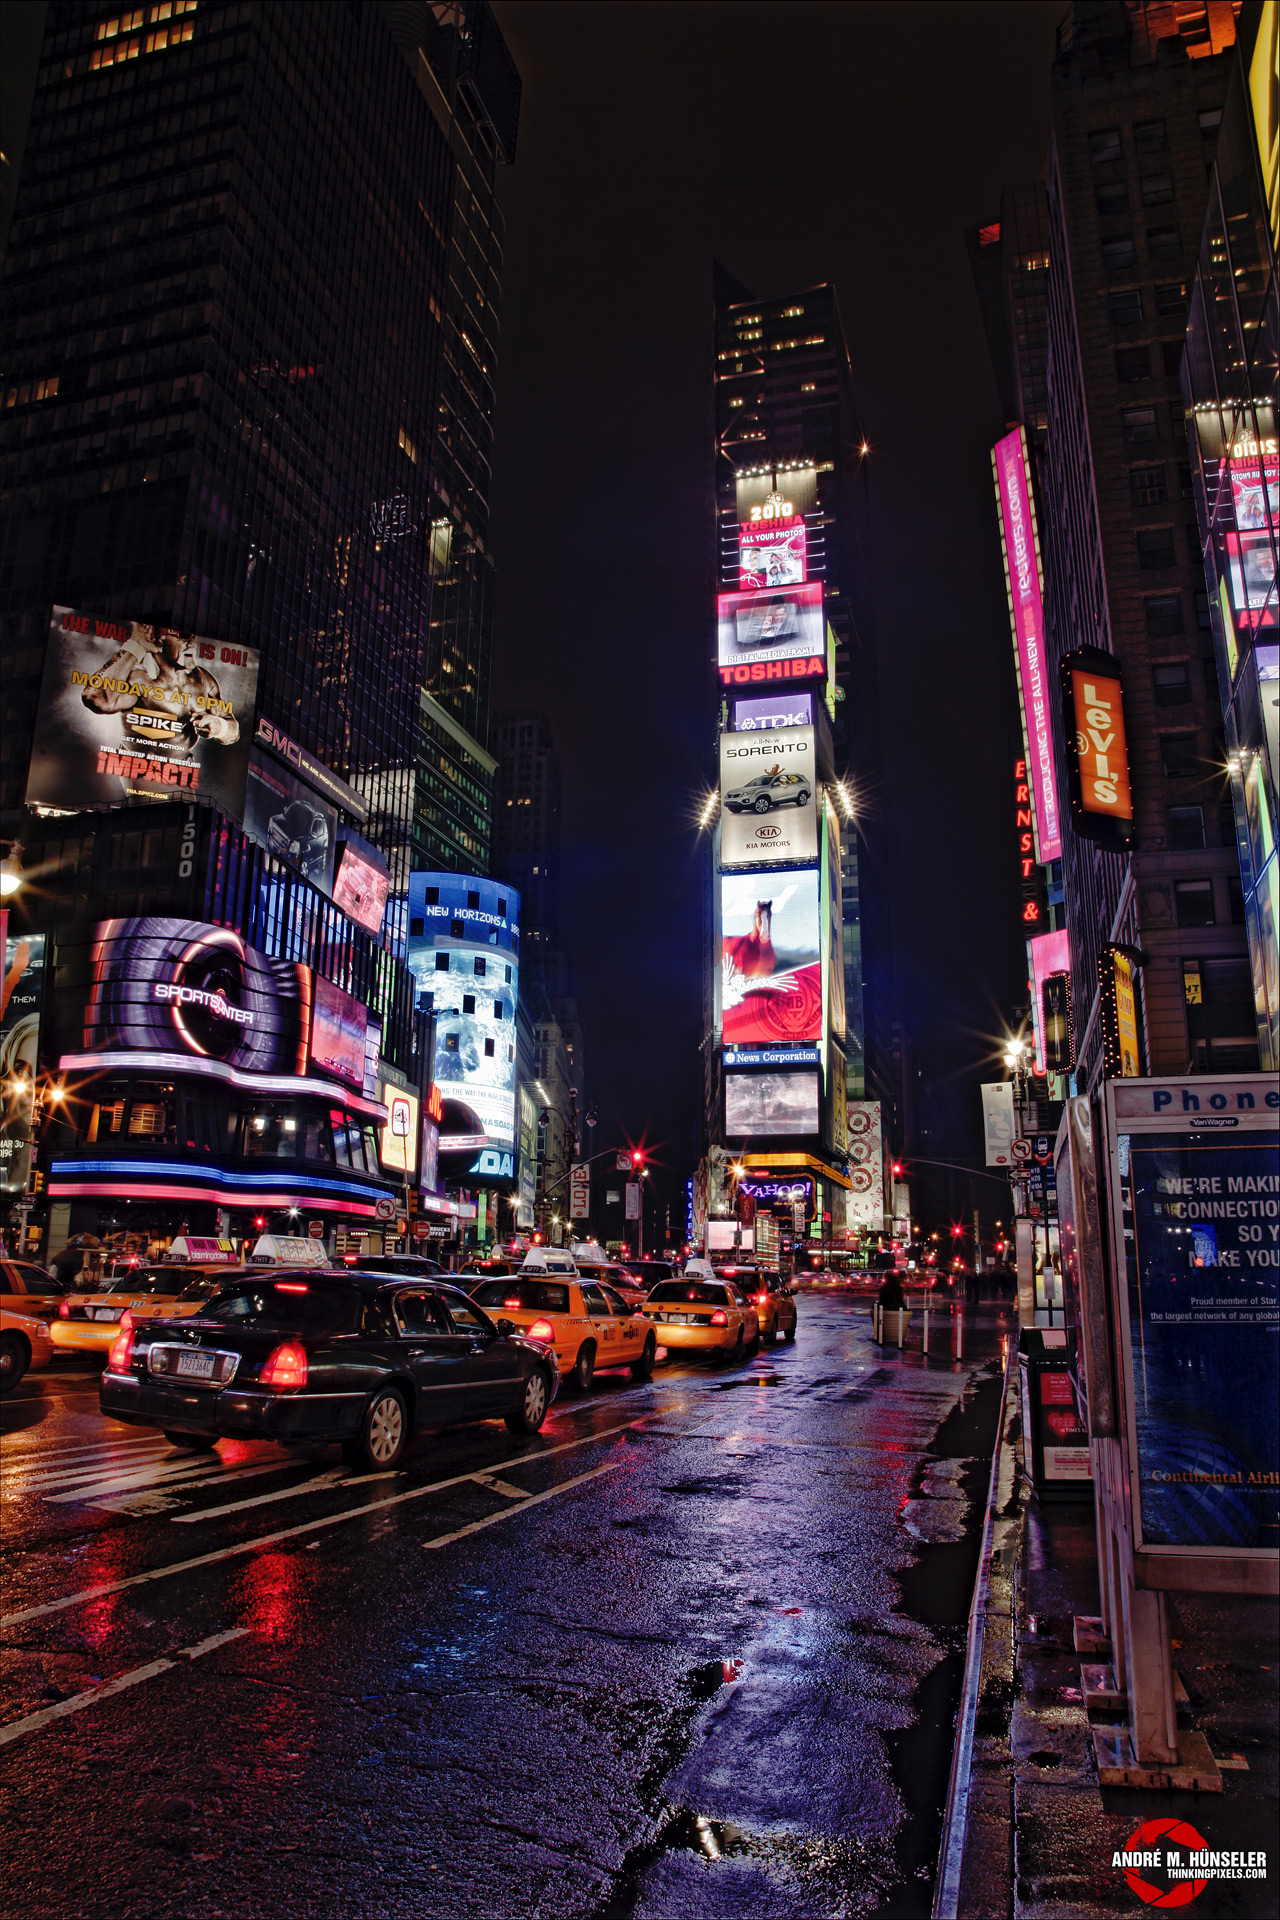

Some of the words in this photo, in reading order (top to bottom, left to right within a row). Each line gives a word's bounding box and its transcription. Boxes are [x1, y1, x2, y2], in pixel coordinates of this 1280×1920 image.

[751, 502, 793, 521] 2010
[741, 514, 804, 532] TOSHIBA
[741, 535, 754, 544] ALL
[755, 533, 775, 542] YOUR
[776, 529, 803, 539] PHOTOS
[61, 613, 90, 635] THE
[95, 620, 129, 642] WAR
[199, 643, 215, 660] IS
[221, 647, 248, 667] ON!
[728, 651, 760, 663] DIGITAL
[760, 649, 786, 660] MEDIA
[787, 646, 814, 656] FRAME
[720, 657, 824, 684] TOSHIBA
[1026, 637, 1043, 697] ALL-NEW
[71, 671, 165, 701] MONDAYS
[169, 692, 192, 706] AT
[196, 696, 234, 714] 9PM
[126, 713, 183, 733] SPIKE
[1033, 700, 1048, 730] THE
[120, 735, 135, 743] GET
[136, 738, 158, 748] MORE
[159, 742, 185, 751] ACTION
[258, 718, 300, 765] GMC
[726, 742, 808, 759] SORENTO
[100, 745, 118, 754] TOTAL
[119, 748, 146, 759] NONSTOP
[147, 754, 168, 763] ACTION
[169, 758, 201, 769] WRESTLING
[1015, 760, 1033, 877] ERNST
[178, 805, 196, 877] 1500
[760, 840, 791, 849] MOTORS
[427, 905, 449, 918] NEW
[454, 908, 501, 927] HORIZONS
[1023, 902, 1039, 920] &
[12, 996, 36, 1004] THEM
[736, 1052, 760, 1063] News
[762, 1051, 817, 1064] Corporation
[465, 1089, 476, 1097] WAY
[1153, 1090, 1278, 1112] Phone
[739, 1182, 811, 1198] YAHOO!
[1166, 1177, 1222, 1195] WE'RE
[1238, 1225, 1263, 1243] SO
[1190, 1297, 1214, 1305] Proud
[1216, 1297, 1248, 1305] member
[1250, 1296, 1260, 1305] of
[1260, 1296, 1277, 1305] Star
[1150, 1312, 1163, 1320] the
[1165, 1312, 1193, 1321] largest
[1194, 1312, 1227, 1320] network
[1229, 1312, 1237, 1320] of
[1239, 1313, 1253, 1322] any
[1255, 1312, 1279, 1321] global
[1052, 1418, 1075, 1427] FREE
[1152, 1470, 1243, 1483] Continental
